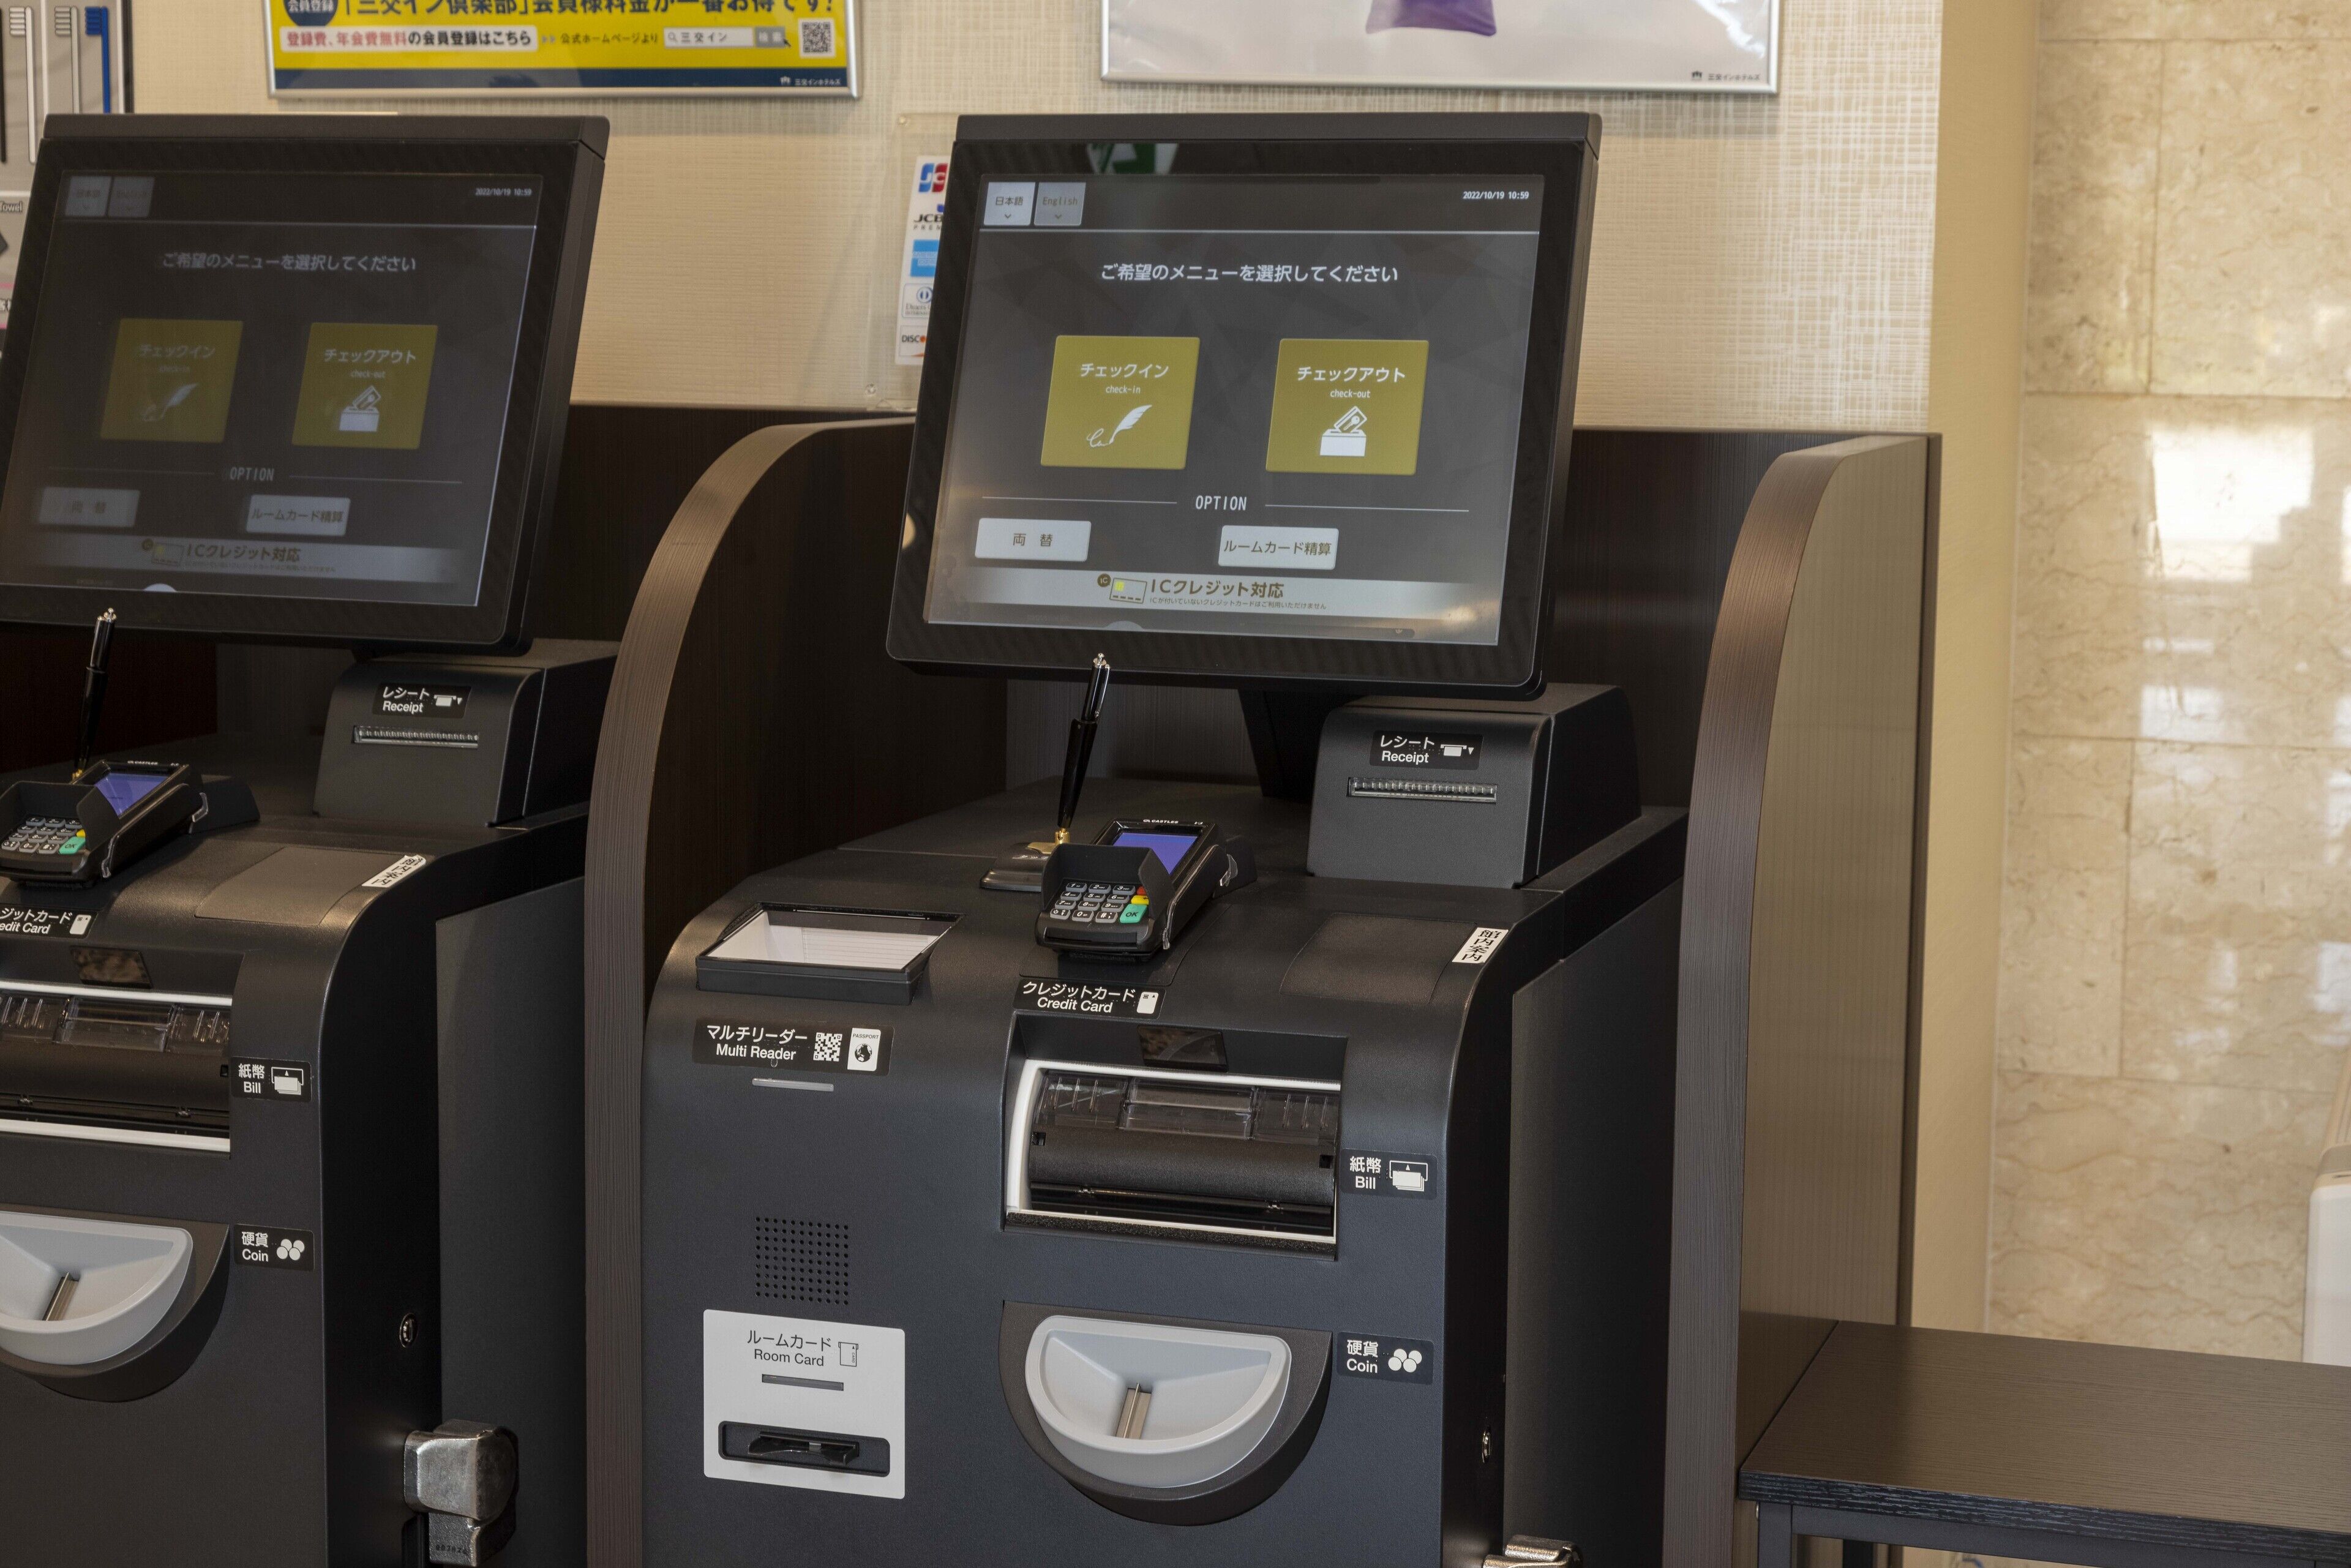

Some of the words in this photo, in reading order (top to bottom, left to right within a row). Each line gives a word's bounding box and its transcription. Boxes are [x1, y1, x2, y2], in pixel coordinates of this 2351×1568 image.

[995, 196, 1024, 206] 日本語
[1042, 196, 1078, 208] English
[1463, 191, 1505, 200] 2022/10/19
[1507, 191, 1529, 200] 10:59
[163, 253, 416, 272] ご希望のメニューを選択してください
[1101, 263, 1398, 283] ご希望のメニューを選択してください
[324, 348, 416, 364] チェックアウト
[1080, 362, 1169, 379] チェックイン
[1297, 366, 1406, 383] チェックアウト
[1105, 385, 1141, 395] check-in
[1330, 389, 1371, 399] check-out
[230, 466, 275, 482] OPTION
[1195, 495, 1248, 512] OPTION
[251, 508, 345, 523] ルームカード精算
[1013, 533, 1053, 547] 両替
[1223, 539, 1332, 556] ルームカード精算
[187, 543, 301, 563] ICクレジット対応
[1151, 579, 1284, 599] ICクレジット対応
[382, 686, 430, 700] レシート
[382, 700, 424, 715] Receipt
[1380, 735, 1435, 750] レシート
[1381, 751, 1430, 765] Receipt
[0, 907, 73, 925] ジットカード
[22, 922, 51, 934] Card
[1461, 929, 1502, 962] 館内案内
[1023, 981, 1136, 1002] クレジットカード
[1037, 997, 1078, 1011] Credit
[1080, 1000, 1113, 1013] Card
[706, 1024, 808, 1045] マルチリーダー
[716, 1043, 747, 1057] Multi
[750, 1045, 797, 1060] Reader
[238, 1063, 265, 1079] 紙幣
[243, 1081, 261, 1094] Bill
[1349, 1155, 1382, 1174] 紙幣
[1355, 1175, 1376, 1190] Bill
[241, 1231, 269, 1248] 硬貨
[241, 1248, 269, 1262] Coin
[747, 1329, 832, 1352] ルームカード
[1347, 1339, 1379, 1358] 硬貨
[754, 1348, 790, 1363] Room
[794, 1353, 825, 1367] Card
[1346, 1358, 1378, 1374] Coin
